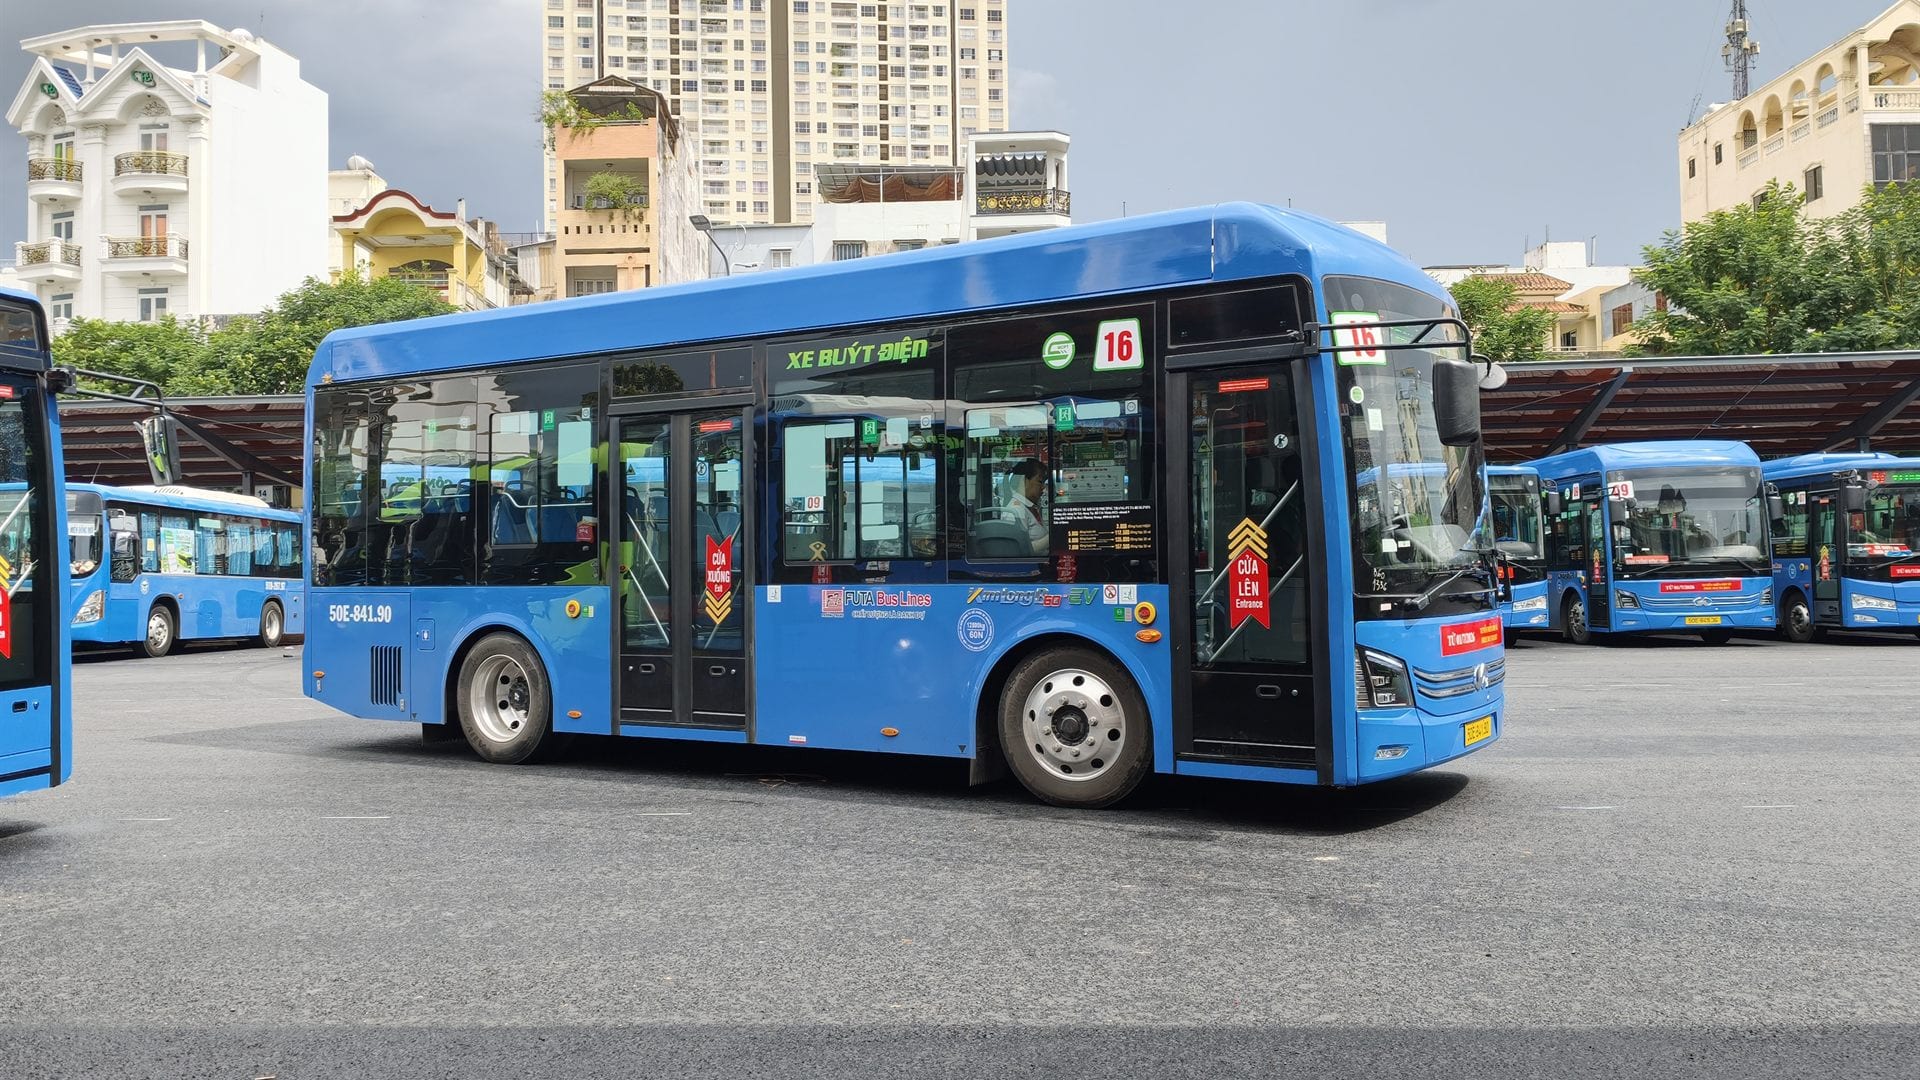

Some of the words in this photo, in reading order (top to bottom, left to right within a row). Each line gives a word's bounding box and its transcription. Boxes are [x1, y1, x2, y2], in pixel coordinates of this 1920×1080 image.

[1104, 330, 1132, 362] 16
[1344, 320, 1377, 357] 16
[786, 350, 815, 370] XE
[817, 341, 875, 367] BUÝT
[877, 336, 929, 364] ĐIỆN
[258, 489, 267, 497] 14
[807, 496, 821, 509] 09
[712, 549, 726, 565] CỬA
[1237, 554, 1259, 575] CỬA
[707, 566, 730, 583] XUỐNG
[714, 584, 723, 592] Exit
[1238, 577, 1259, 596] LÊN
[844, 590, 875, 606] FUTA
[876, 590, 898, 606] Bus
[899, 590, 932, 606] Lines
[1235, 599, 1263, 609] Entrance
[329, 604, 392, 623] 50E-841.90
